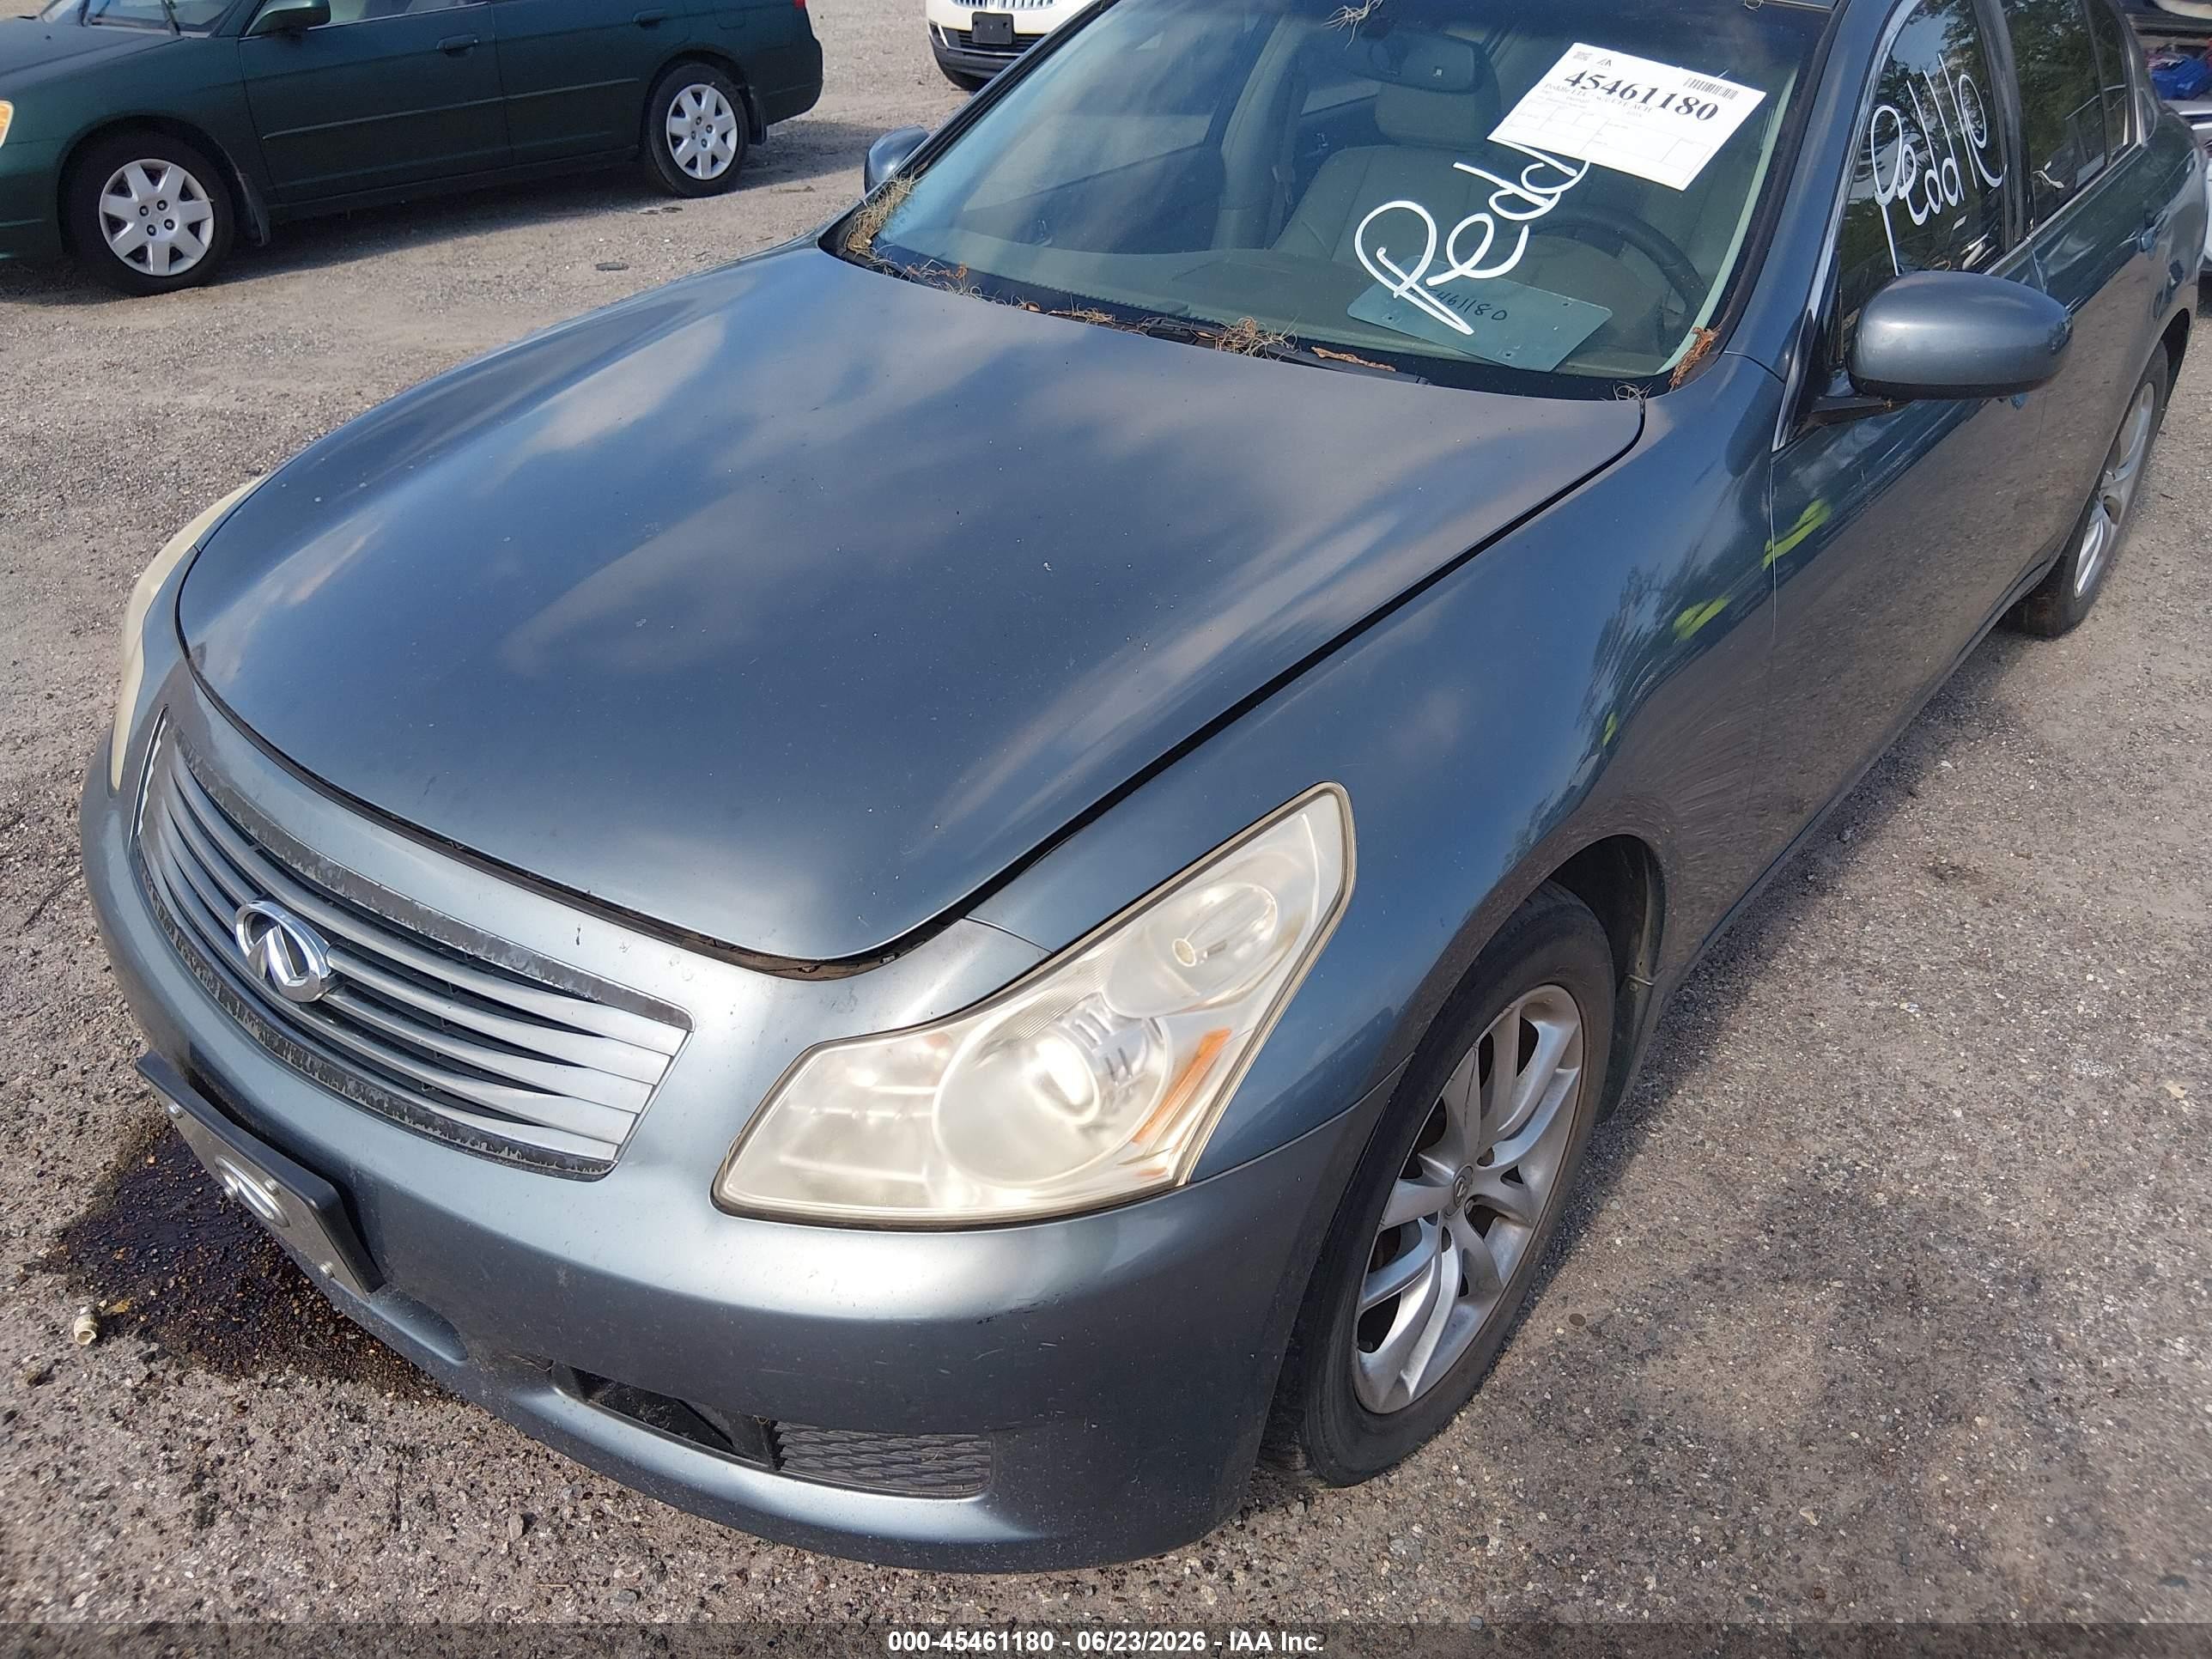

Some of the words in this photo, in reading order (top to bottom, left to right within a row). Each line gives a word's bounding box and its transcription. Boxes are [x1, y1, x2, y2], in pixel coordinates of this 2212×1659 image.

[1563, 69, 1720, 121] 45461180
[1869, 52, 2008, 276] Peddle
[1354, 137, 1591, 336] Pedd
